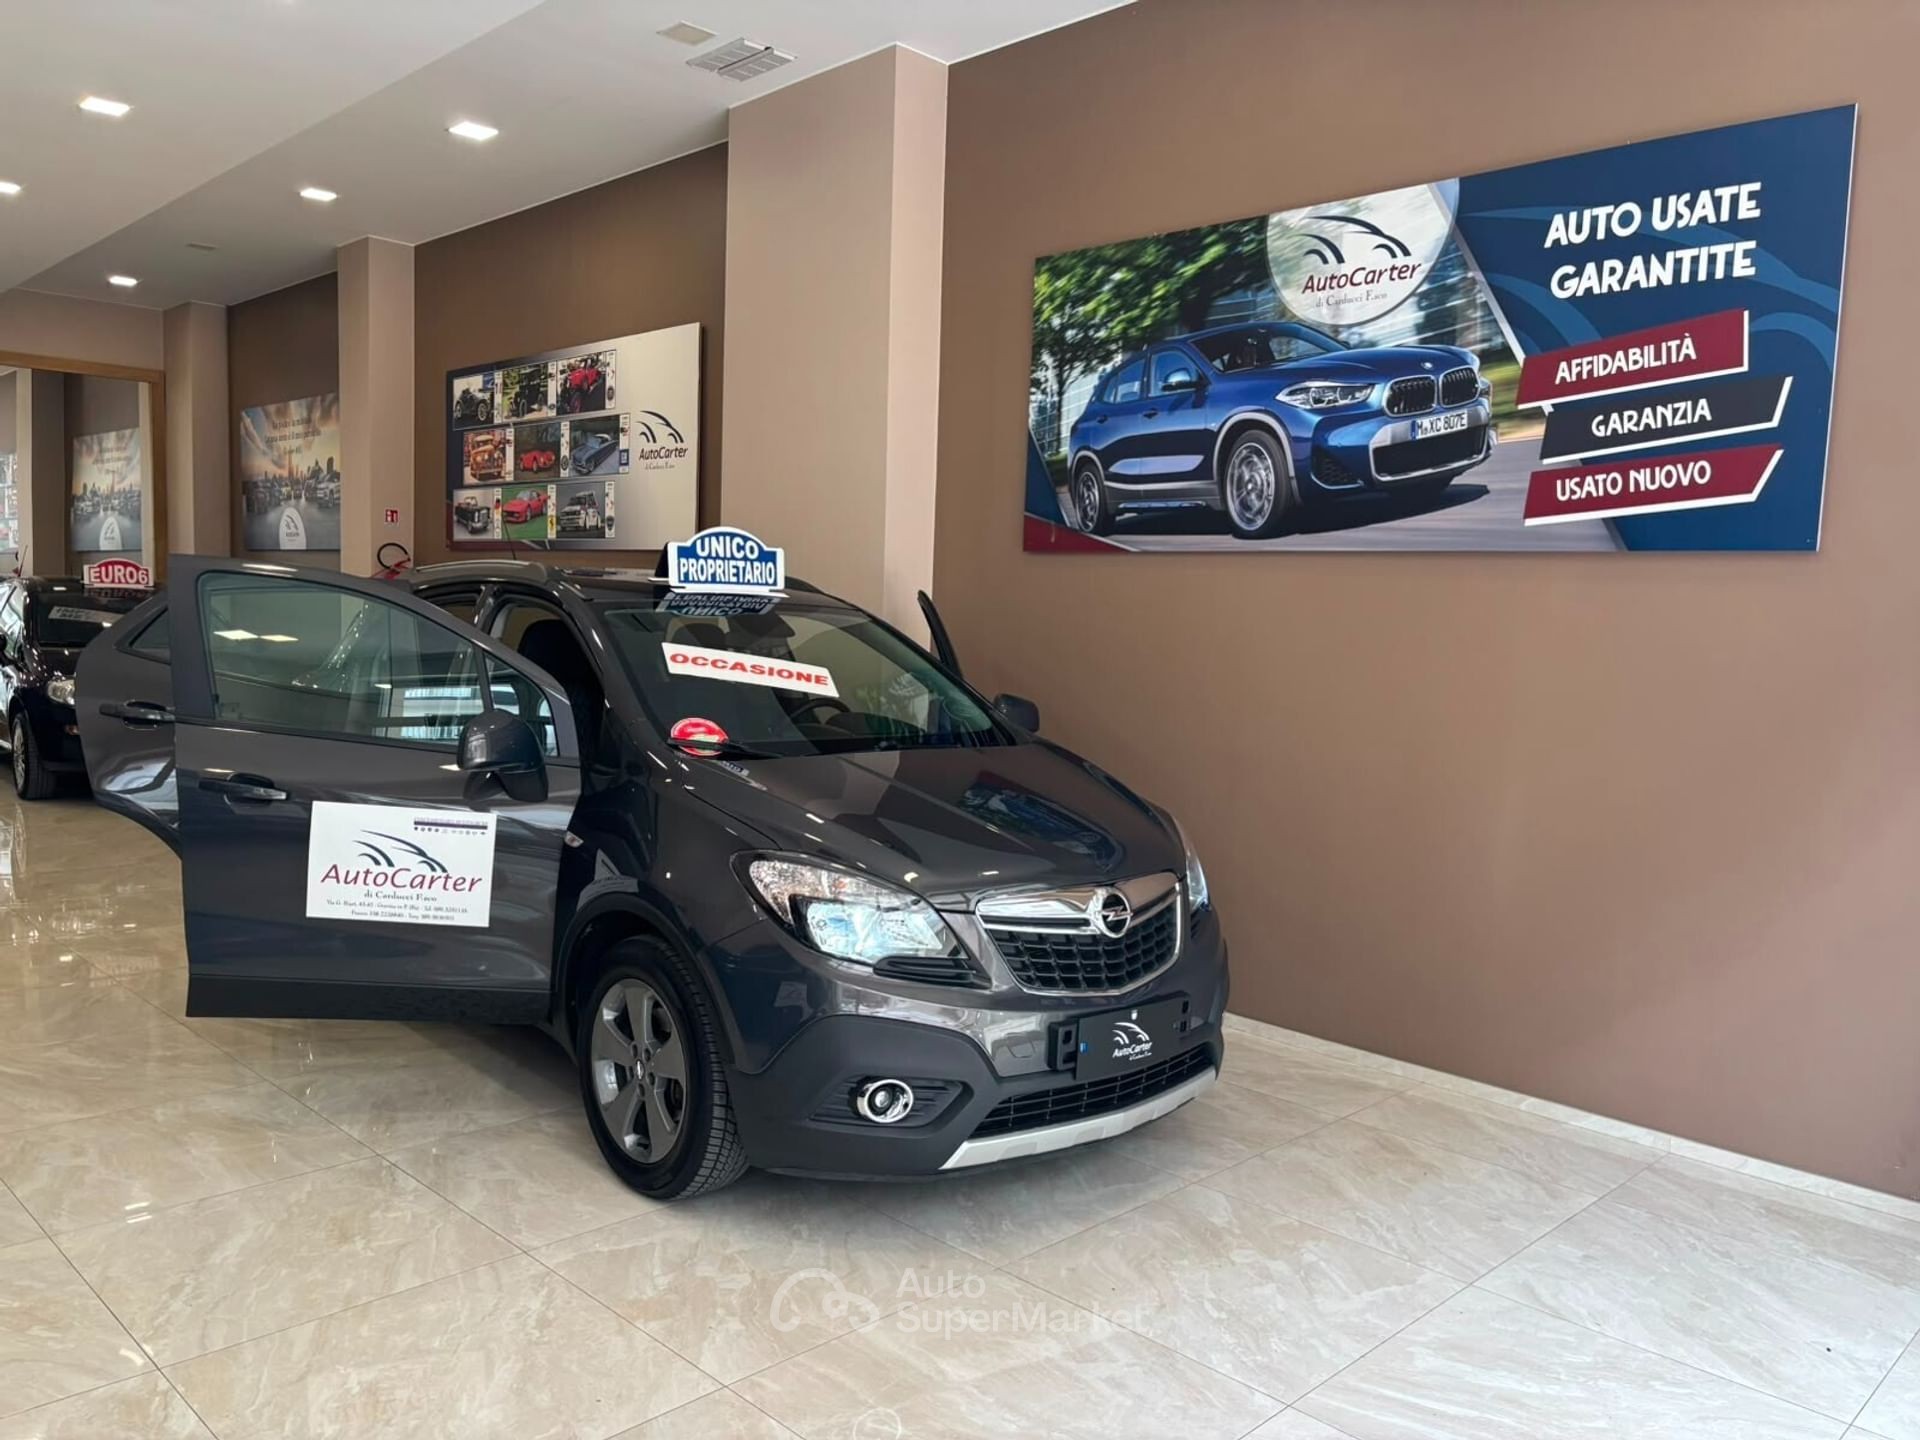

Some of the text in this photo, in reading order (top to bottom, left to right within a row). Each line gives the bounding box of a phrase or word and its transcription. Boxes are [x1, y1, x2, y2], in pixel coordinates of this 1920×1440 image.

[1543, 182, 1761, 248] AUTO USATE
[1302, 263, 1421, 294] AutoCarter
[1550, 240, 1757, 299] GARANTITE
[1555, 333, 1697, 384] AFFIDABILITÀ
[1591, 398, 1712, 437] GARANZIA
[638, 446, 689, 461] AutoCarter
[1556, 460, 1712, 501] USATO NUOVO
[695, 536, 759, 559] UNICO
[89, 565, 148, 584] EURO6
[680, 558, 775, 585] PROPRIETARIO
[670, 653, 829, 687] OCCASIONE
[320, 864, 483, 892] AutoCarter
[1112, 1042, 1153, 1058] AutoCarter
